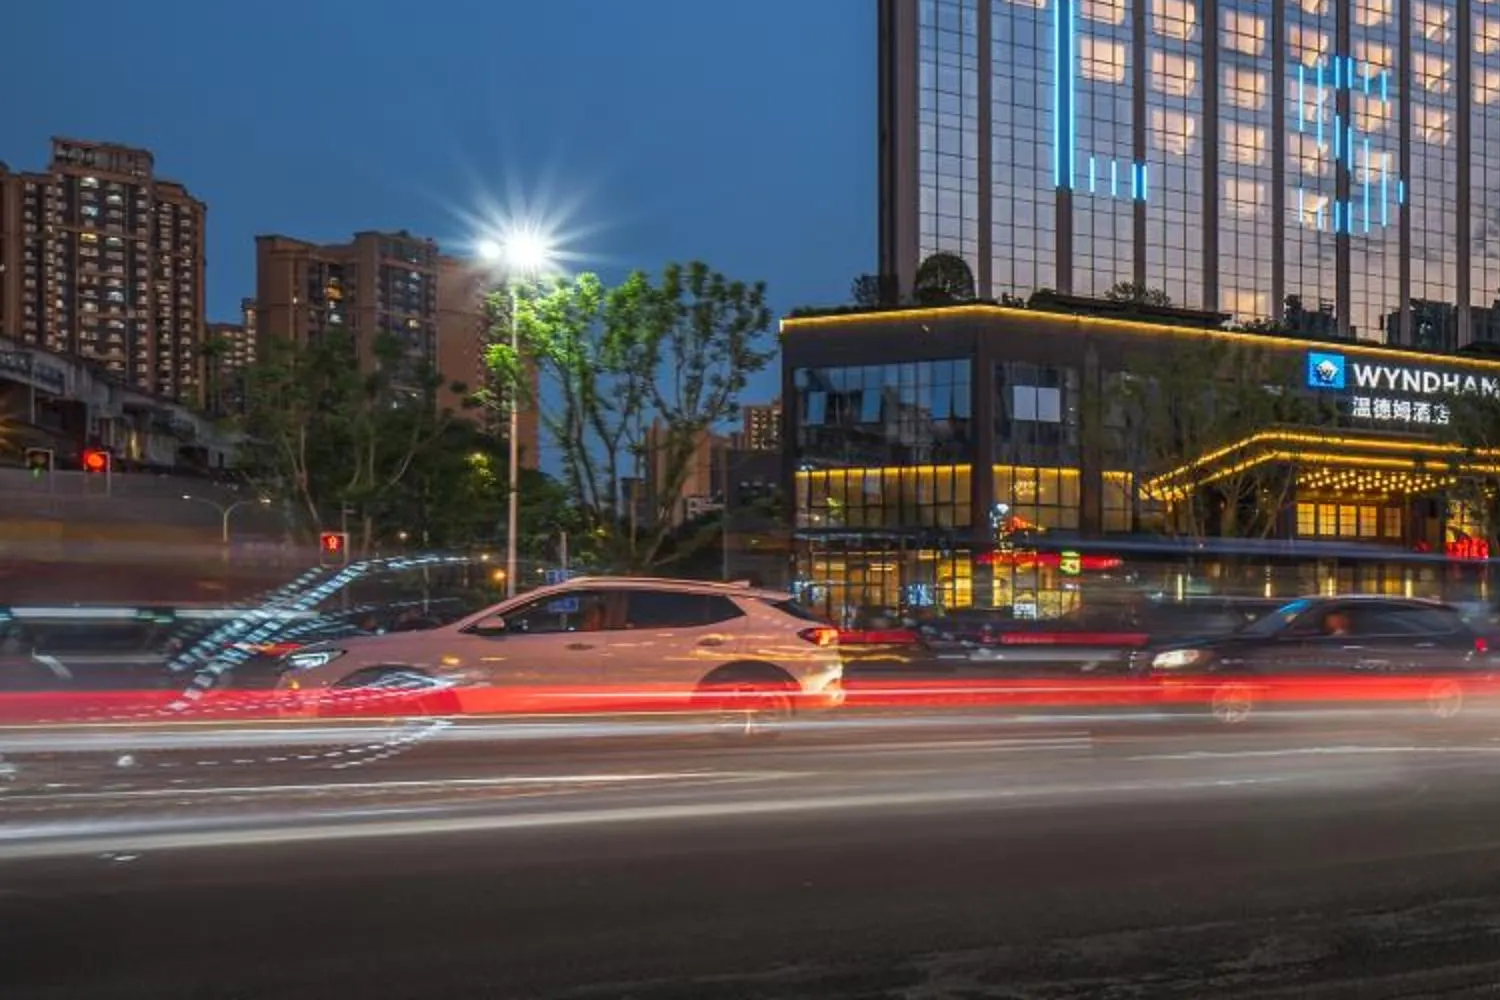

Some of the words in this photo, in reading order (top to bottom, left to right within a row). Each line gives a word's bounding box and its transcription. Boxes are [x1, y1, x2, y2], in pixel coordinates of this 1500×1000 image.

[1352, 397, 1451, 425] 温德姆酒店
